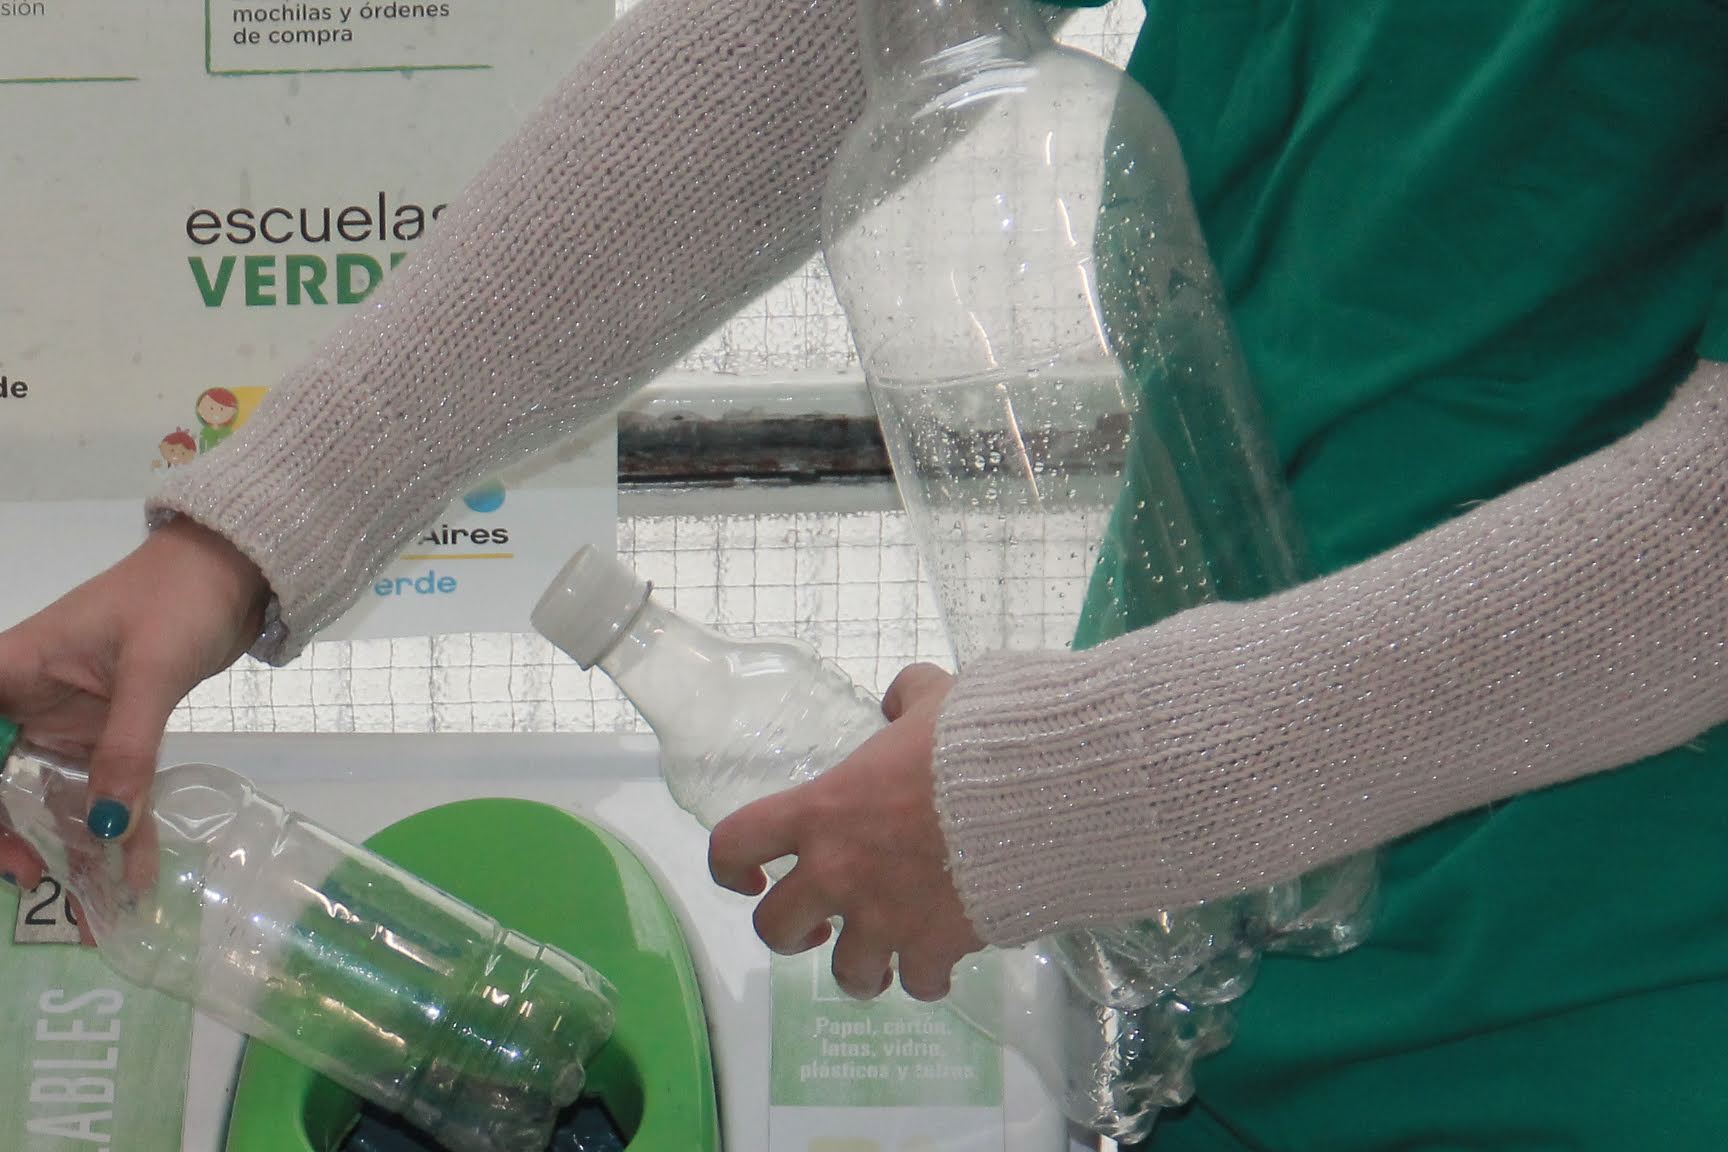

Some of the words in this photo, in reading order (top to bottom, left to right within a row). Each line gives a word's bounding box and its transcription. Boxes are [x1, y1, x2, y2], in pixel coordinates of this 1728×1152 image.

[233, 4, 332, 23] mochilas
[339, 8, 352, 22] y
[360, 2, 450, 19] órdenes
[233, 28, 260, 44] de
[268, 28, 353, 45] compra
[186, 191, 448, 245] escuela
[188, 251, 408, 307] VERD
[374, 568, 457, 596] erde
[25, 876, 78, 925] 2
